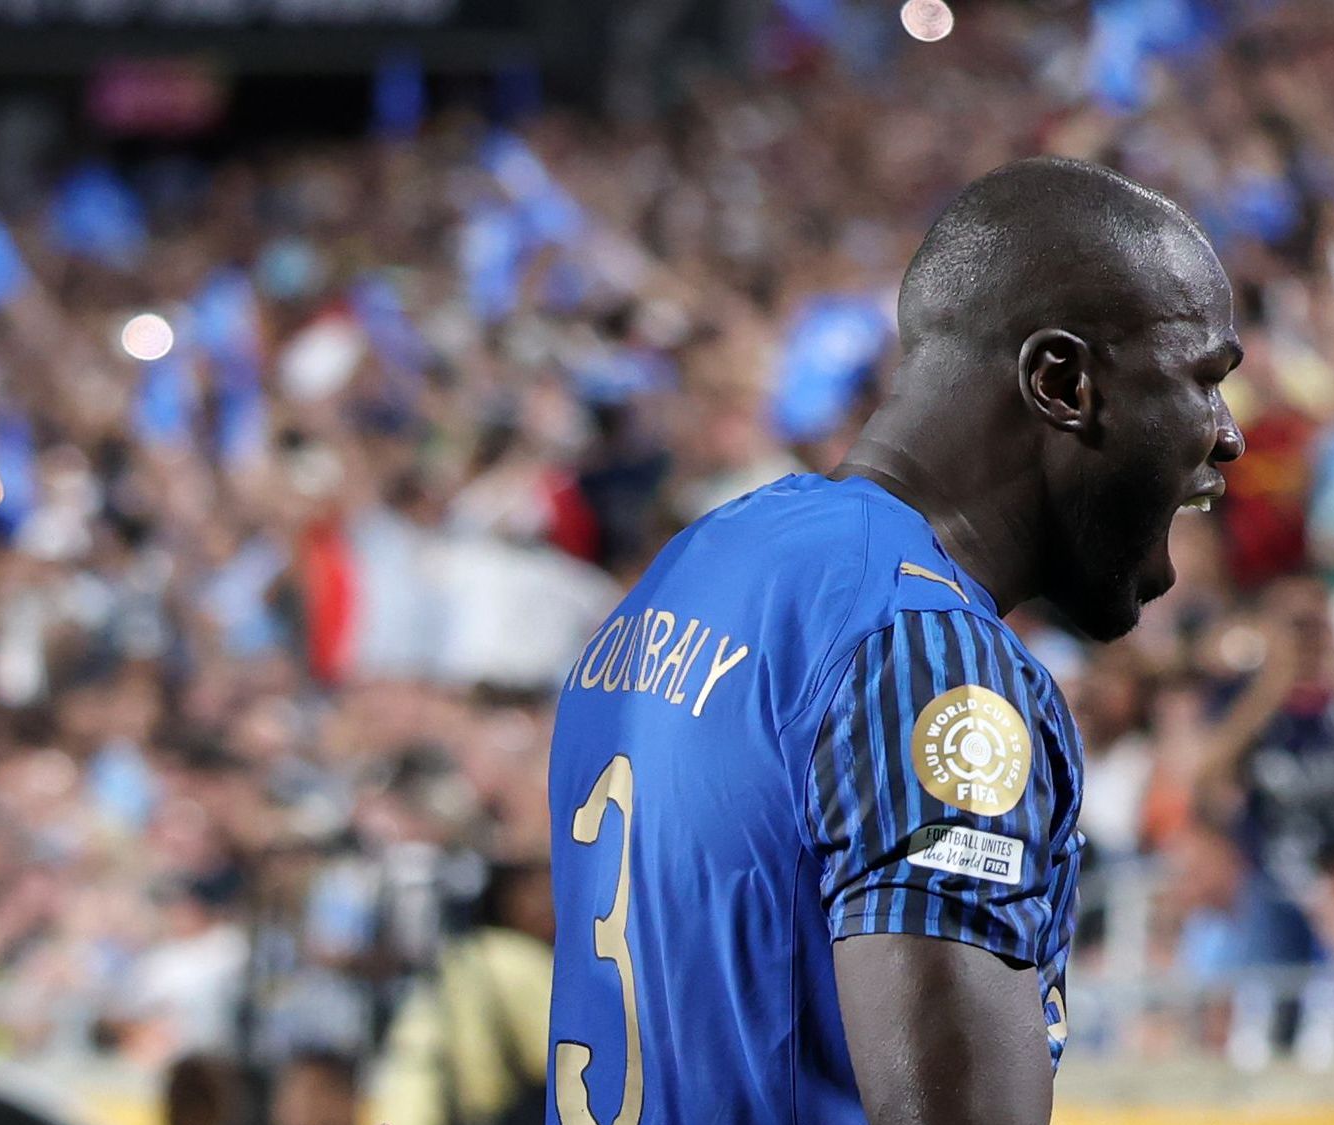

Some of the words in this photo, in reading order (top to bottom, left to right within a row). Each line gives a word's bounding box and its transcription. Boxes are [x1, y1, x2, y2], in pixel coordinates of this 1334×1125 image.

[927, 698, 978, 737] WORLD
[982, 703, 1012, 727] CUP
[925, 743, 950, 783] CLUB
[1003, 759, 1022, 789] USA
[957, 783, 998, 806] FIFA
[927, 827, 978, 850] FOOTBALL
[981, 837, 1013, 857] UNITES
[923, 845, 944, 861] the
[946, 847, 984, 872] World
[984, 859, 1009, 875] FIFA
